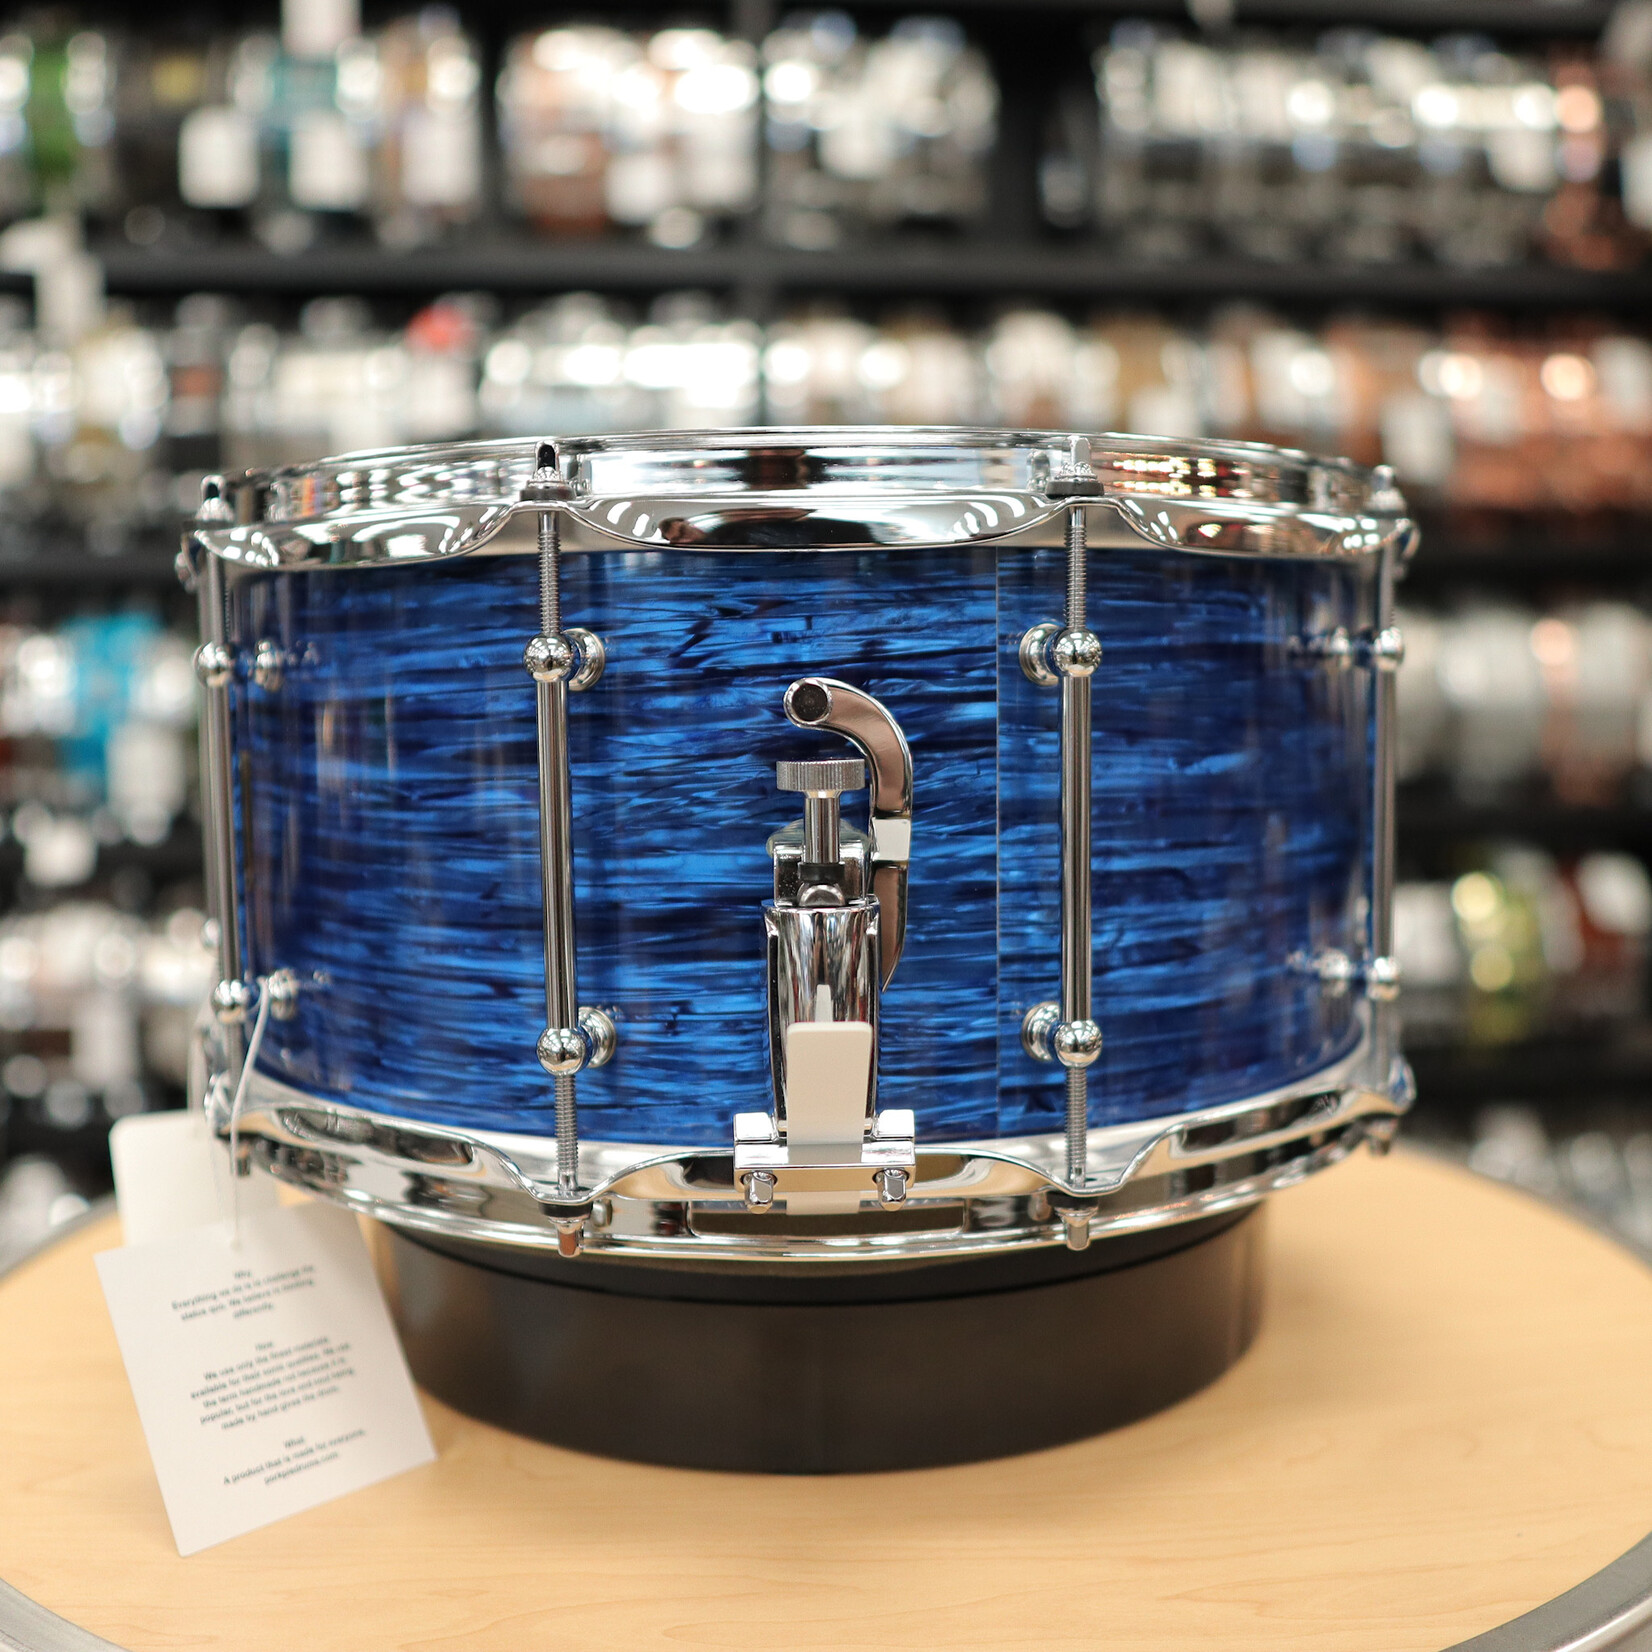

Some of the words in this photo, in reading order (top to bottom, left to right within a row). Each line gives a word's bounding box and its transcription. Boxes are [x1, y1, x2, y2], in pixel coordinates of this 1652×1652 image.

[171, 1291, 217, 1311] Everything
[190, 1382, 228, 1399] available
[218, 1392, 237, 1404] term
[221, 1416, 245, 1430] made
[231, 1464, 265, 1484] product
[266, 1457, 282, 1469] that
